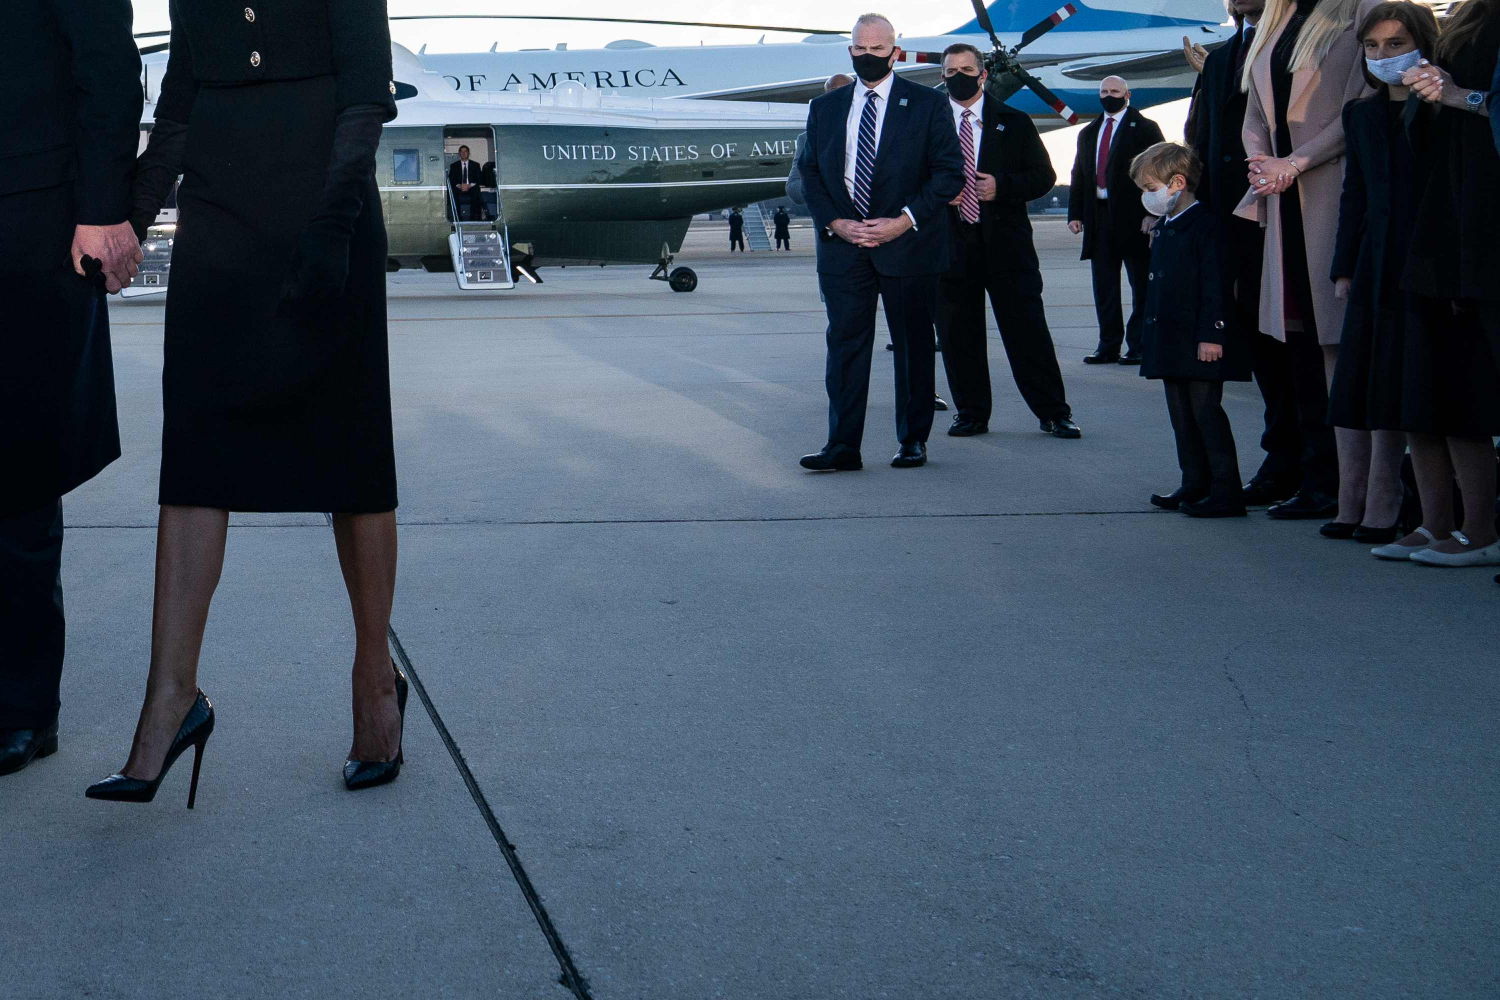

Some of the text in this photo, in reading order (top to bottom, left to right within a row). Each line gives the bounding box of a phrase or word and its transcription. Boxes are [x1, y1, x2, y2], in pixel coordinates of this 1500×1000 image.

[500, 68, 688, 91] AMERICA
[542, 145, 617, 160] UNITED
[628, 144, 699, 161] STATES
[710, 143, 737, 159] OF
